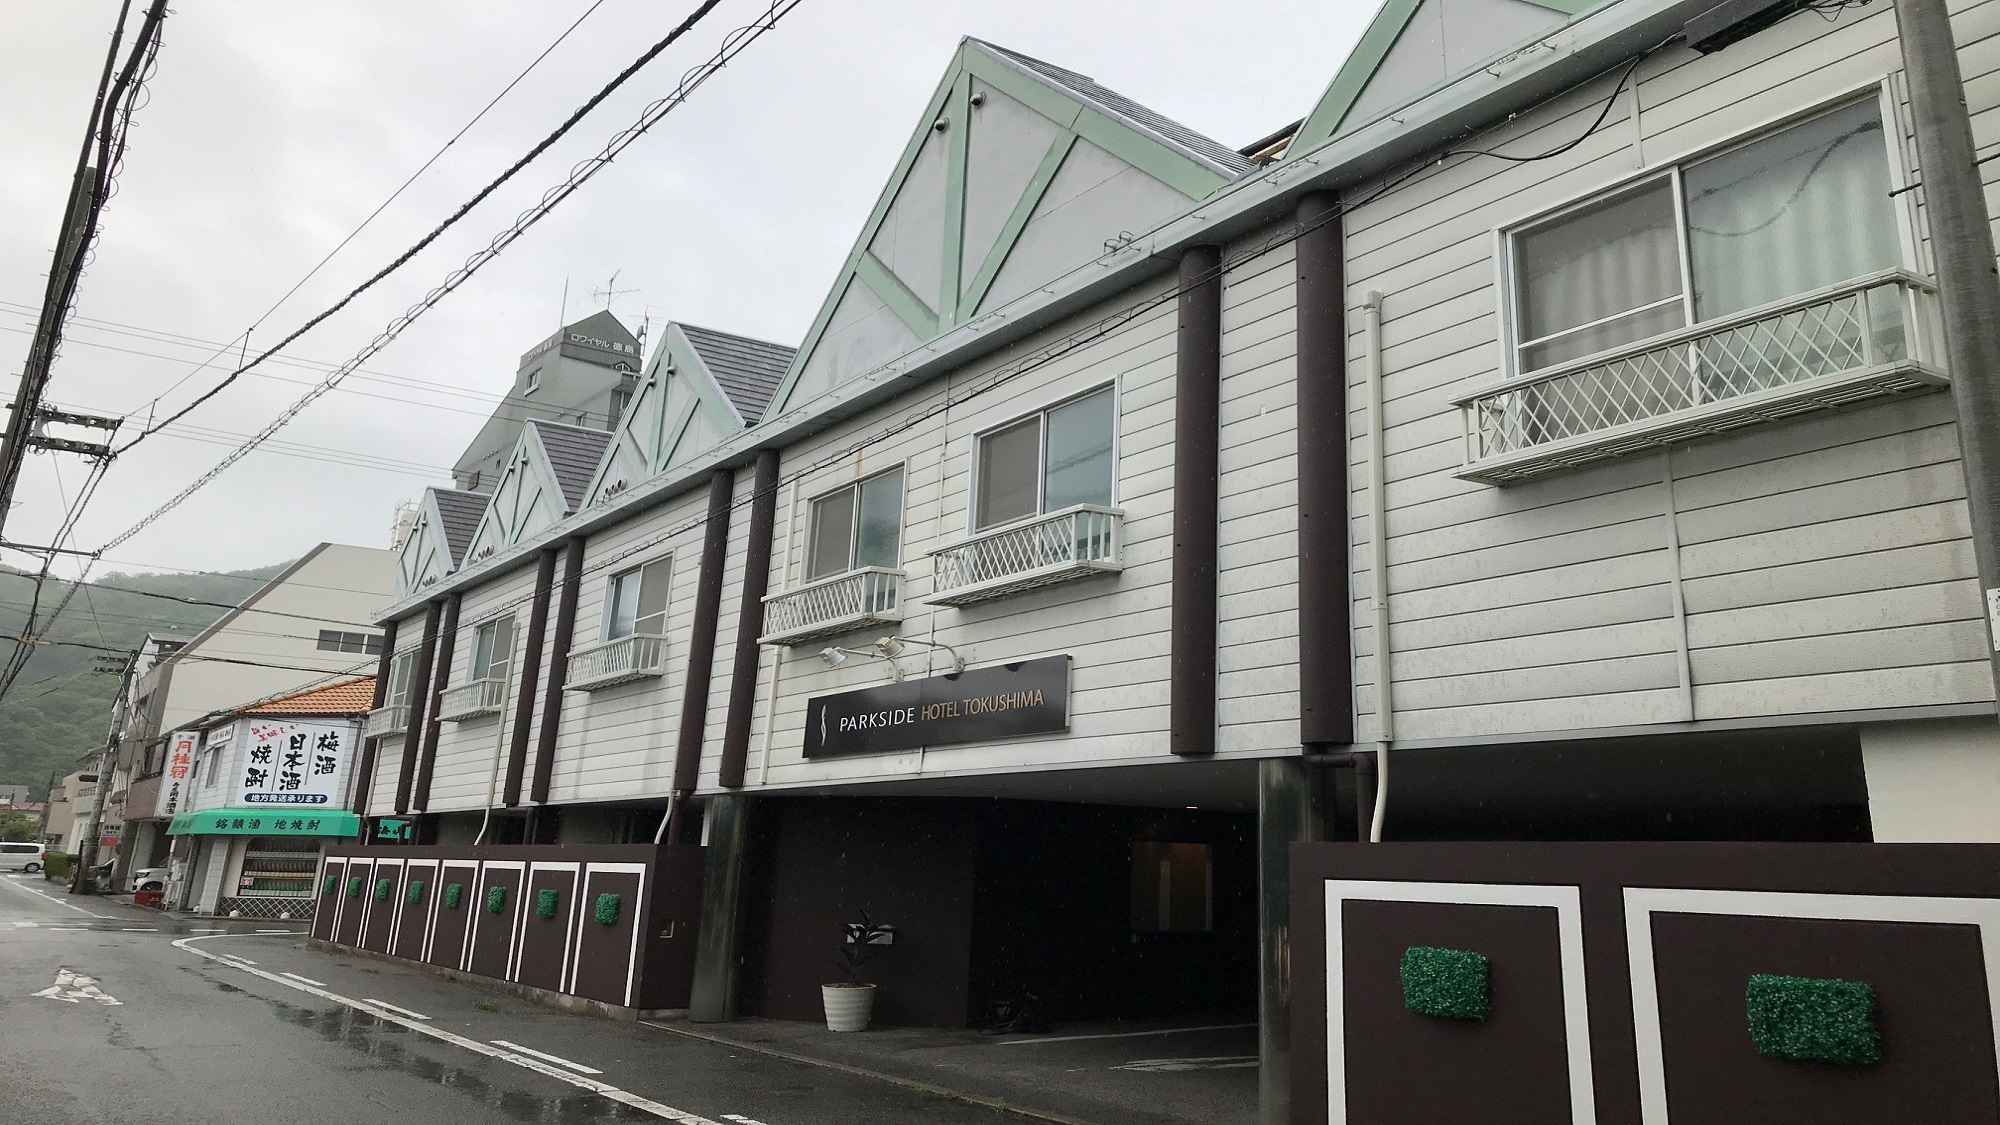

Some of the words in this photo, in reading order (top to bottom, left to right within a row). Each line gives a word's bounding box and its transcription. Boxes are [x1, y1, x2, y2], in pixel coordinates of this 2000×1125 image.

[571, 333, 609, 348] ロワイヤル
[613, 342, 634, 354] 徳島
[839, 707, 915, 732] PARKSIDE
[921, 701, 960, 721] HOTEL
[963, 689, 1044, 716] TOKUSHIMA
[169, 740, 193, 780] 月桂冠
[245, 744, 273, 788] 焼酎
[279, 733, 307, 791] 日本酒
[314, 731, 340, 775] 梅酒
[250, 794, 324, 803] 地方発送承ります
